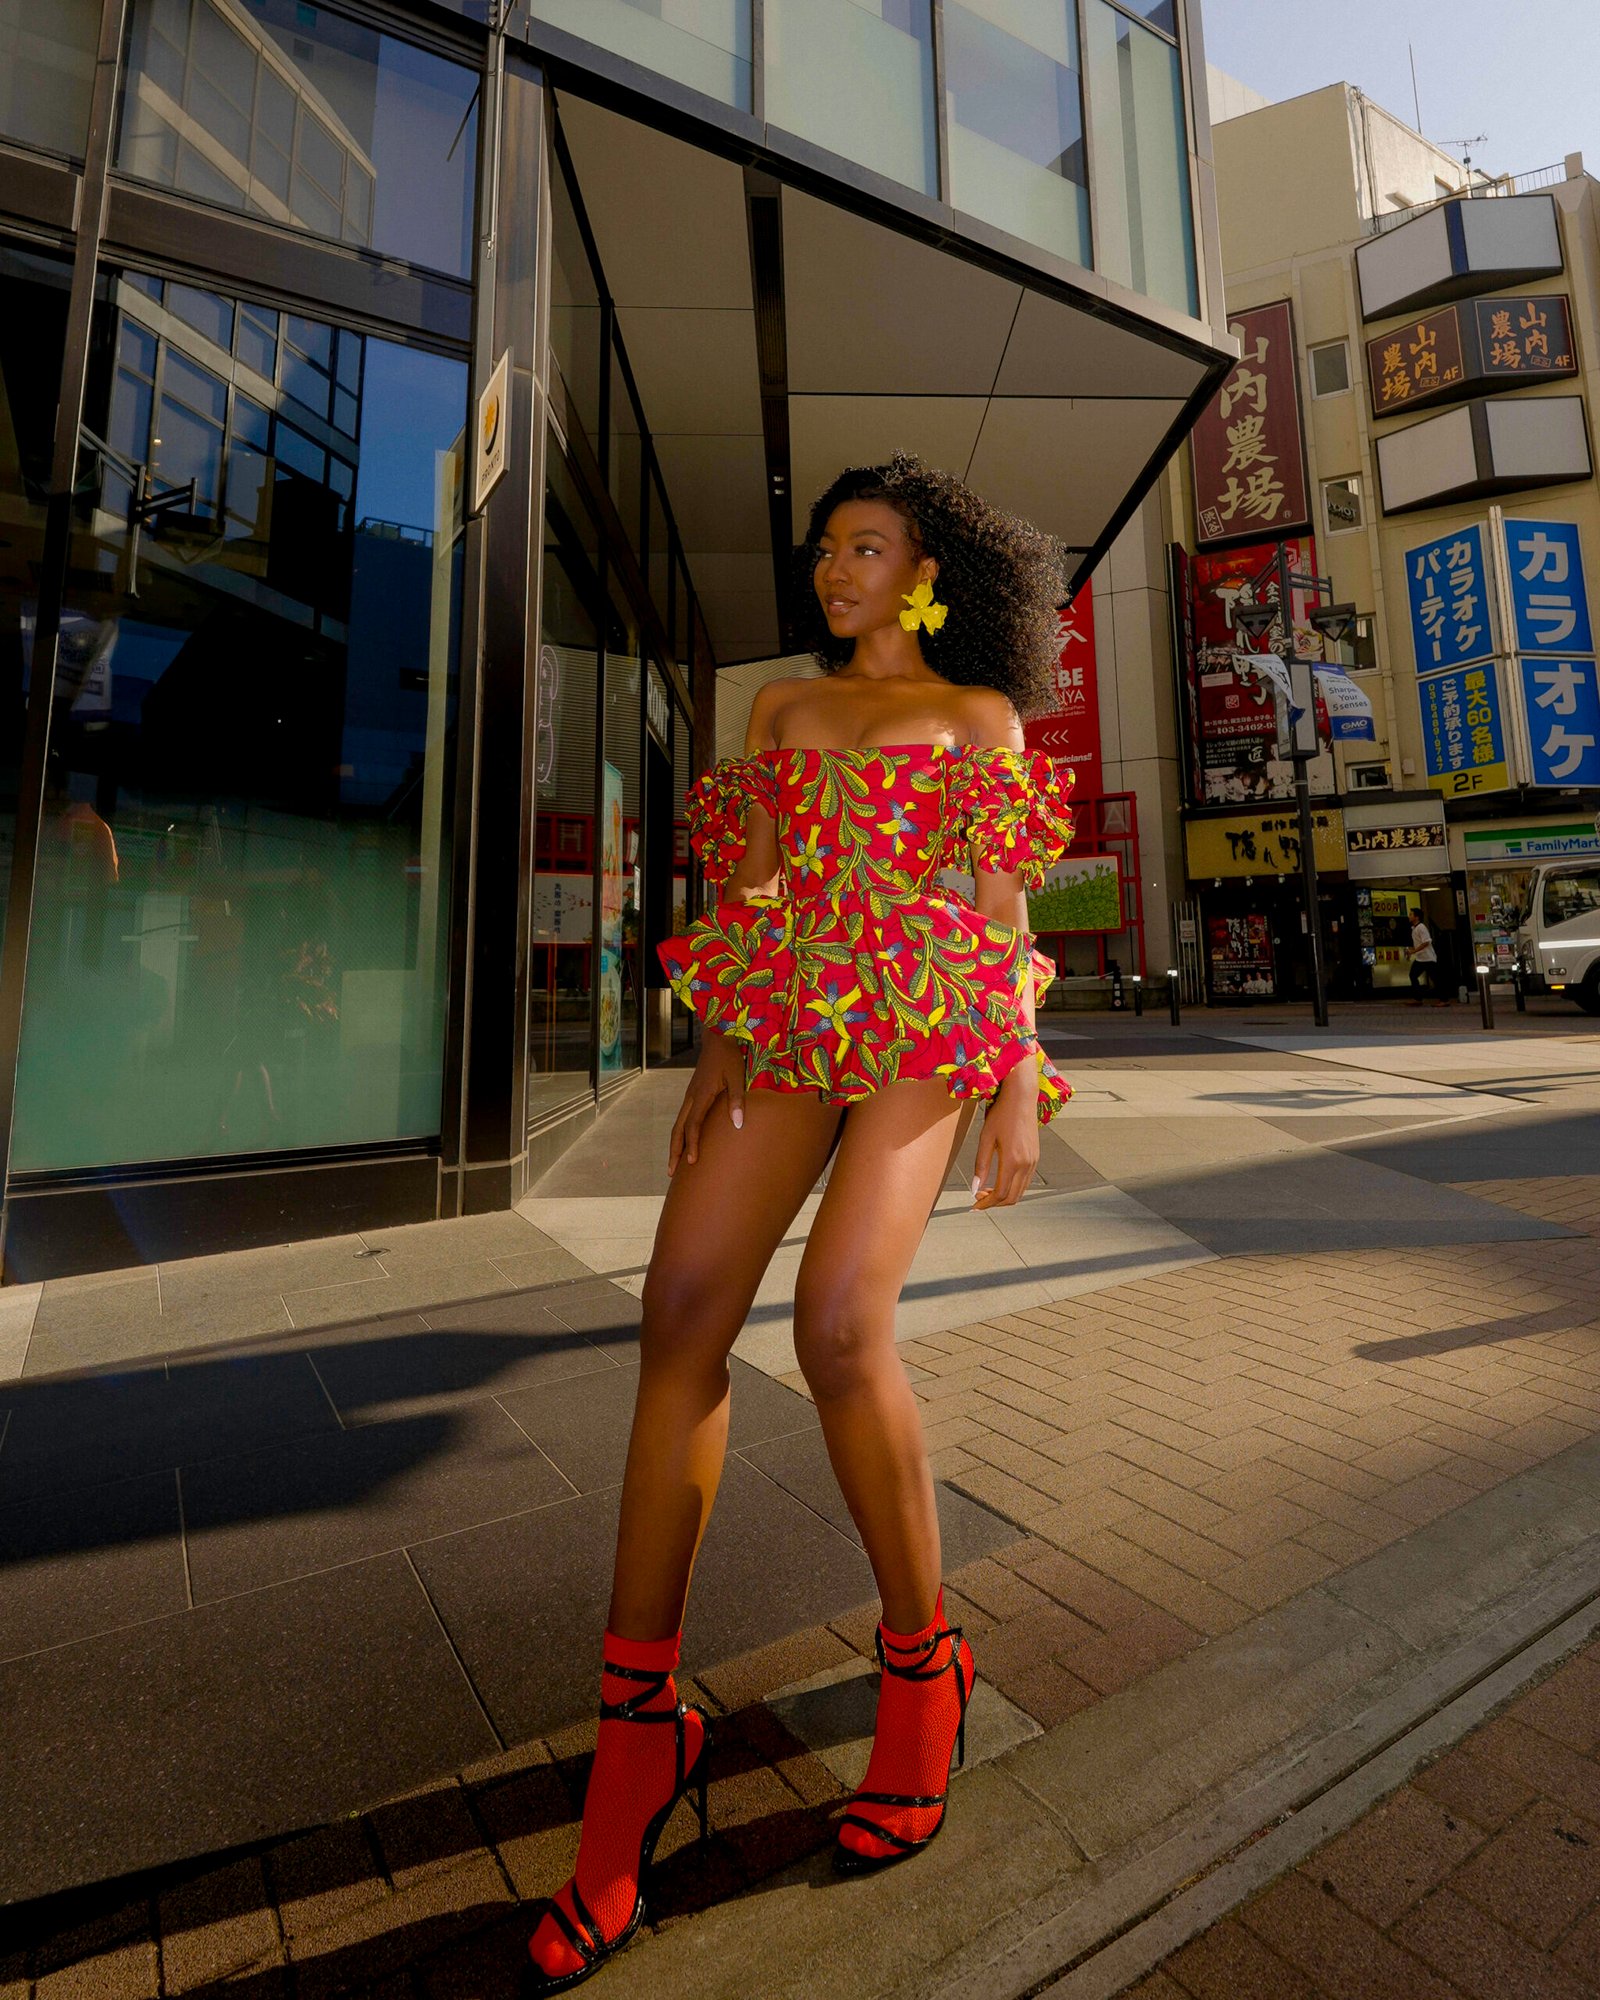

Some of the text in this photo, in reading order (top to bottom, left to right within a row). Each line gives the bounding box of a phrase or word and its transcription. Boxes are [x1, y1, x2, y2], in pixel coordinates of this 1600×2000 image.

[1518, 301, 1549, 355] 山内
[1409, 325, 1437, 379] 山内
[1554, 355, 1571, 366] 4F
[1443, 366, 1459, 380] 4F
[1219, 322, 1286, 521] 山内農場
[481, 449, 500, 485] PRONTO
[1415, 547, 1445, 662] パーティー
[1446, 541, 1482, 652] カラオケ
[1518, 532, 1595, 778] カラオケ
[1049, 667, 1084, 689] EBE
[1338, 694, 1358, 702] Your
[1341, 719, 1368, 731] GMO
[1441, 678, 1466, 770] ご予約承ります
[1464, 670, 1495, 765] 最大60名様
[1453, 773, 1483, 792] 2F
[1351, 827, 1430, 851] 山内農場
[1527, 837, 1600, 852] FamilyMart
